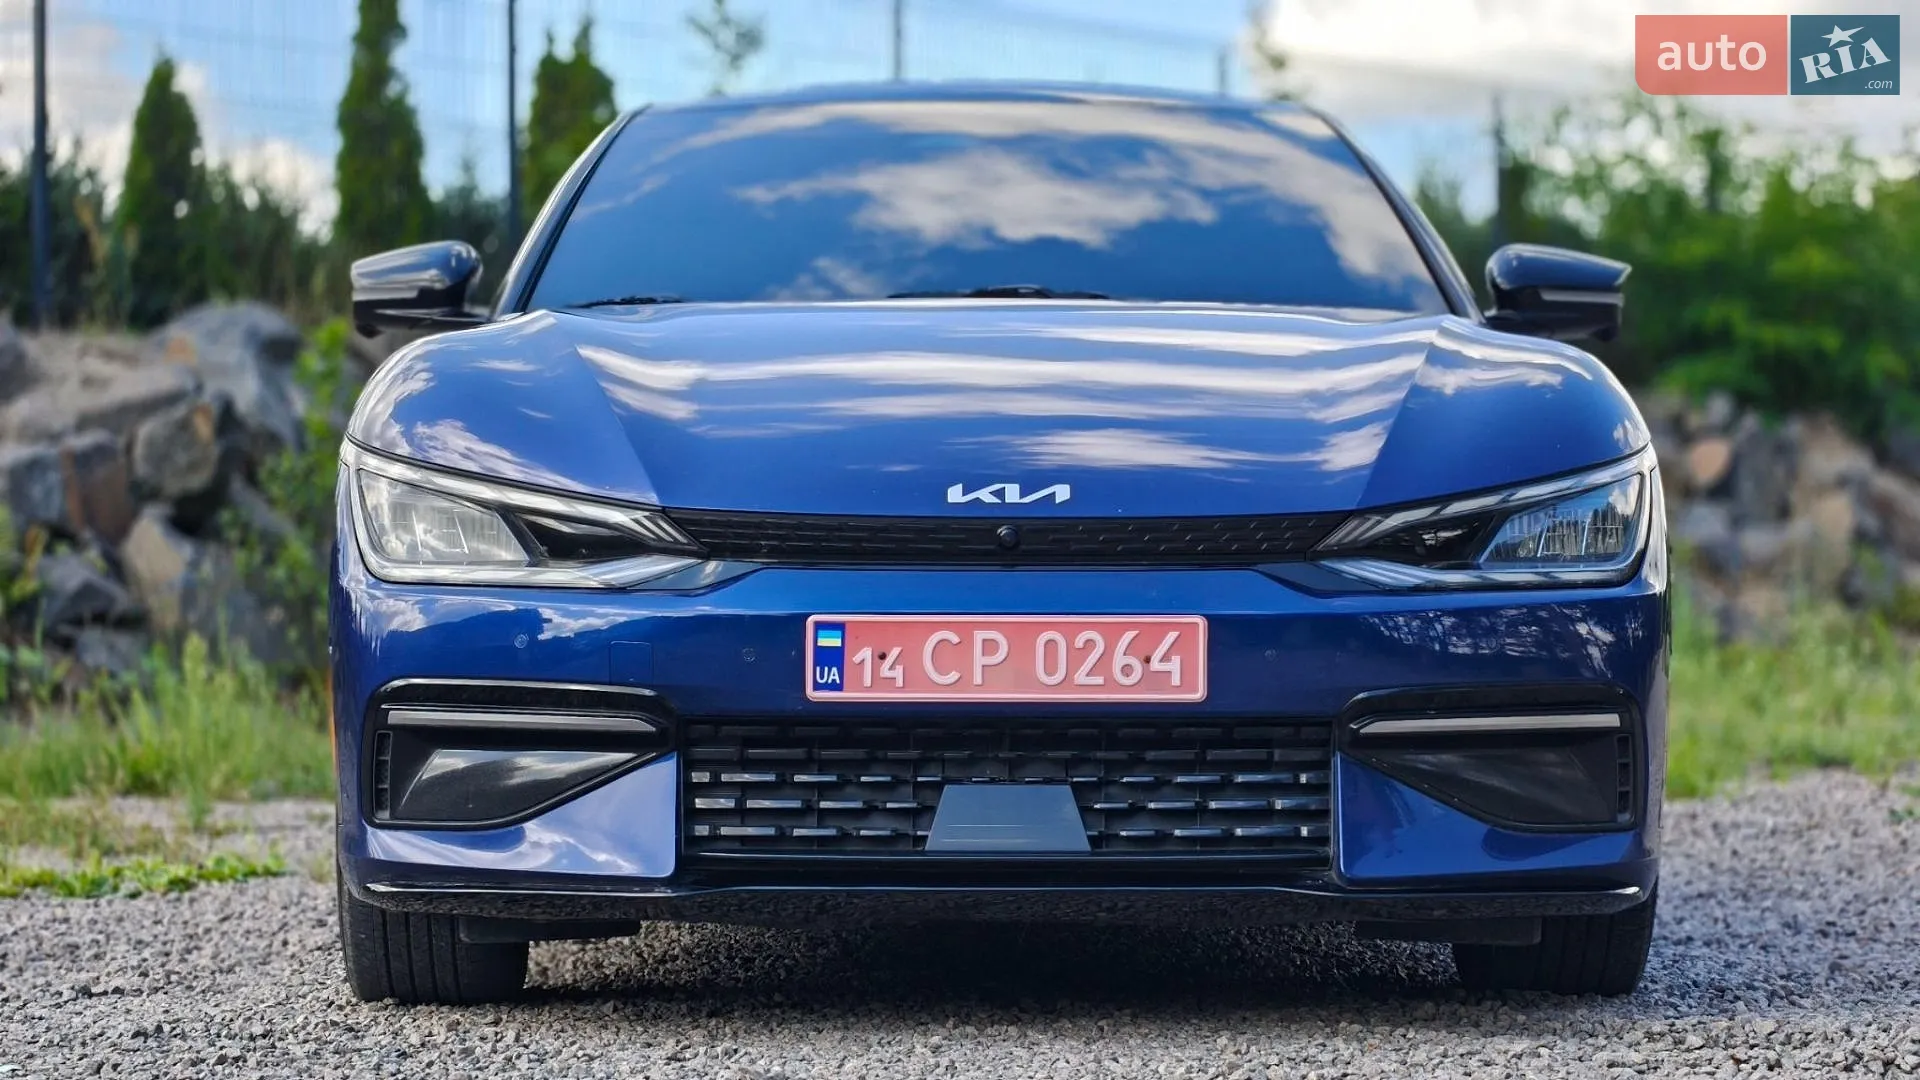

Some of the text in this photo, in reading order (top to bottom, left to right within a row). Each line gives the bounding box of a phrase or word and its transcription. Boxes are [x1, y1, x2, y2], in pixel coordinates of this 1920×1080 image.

[948, 483, 1071, 504] KIA
[852, 630, 1181, 687] 14 CP 0264
[816, 666, 840, 684] UA
